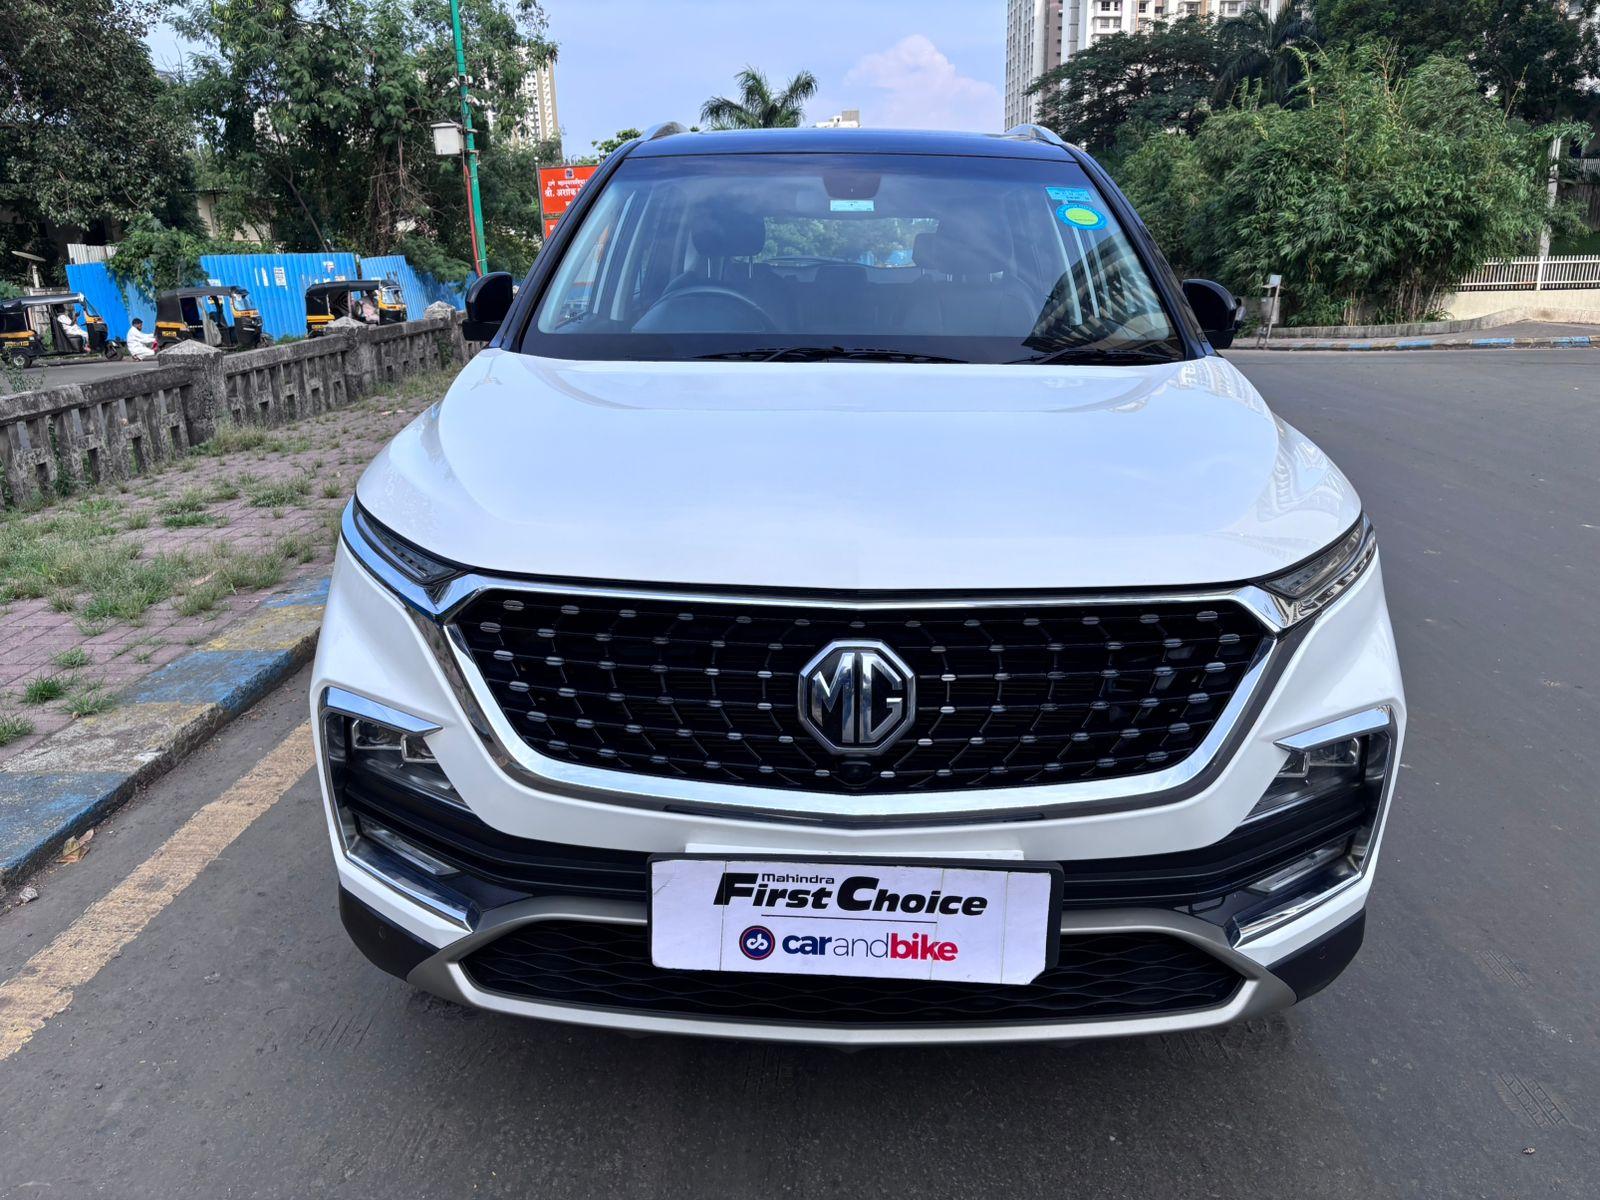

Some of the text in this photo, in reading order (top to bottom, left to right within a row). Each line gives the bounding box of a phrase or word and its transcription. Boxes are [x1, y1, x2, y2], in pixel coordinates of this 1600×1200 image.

[811, 652, 903, 744] MG
[713, 872, 988, 916] First Choice
[761, 873, 835, 885] Mahindra
[782, 932, 959, 962] carandbike
